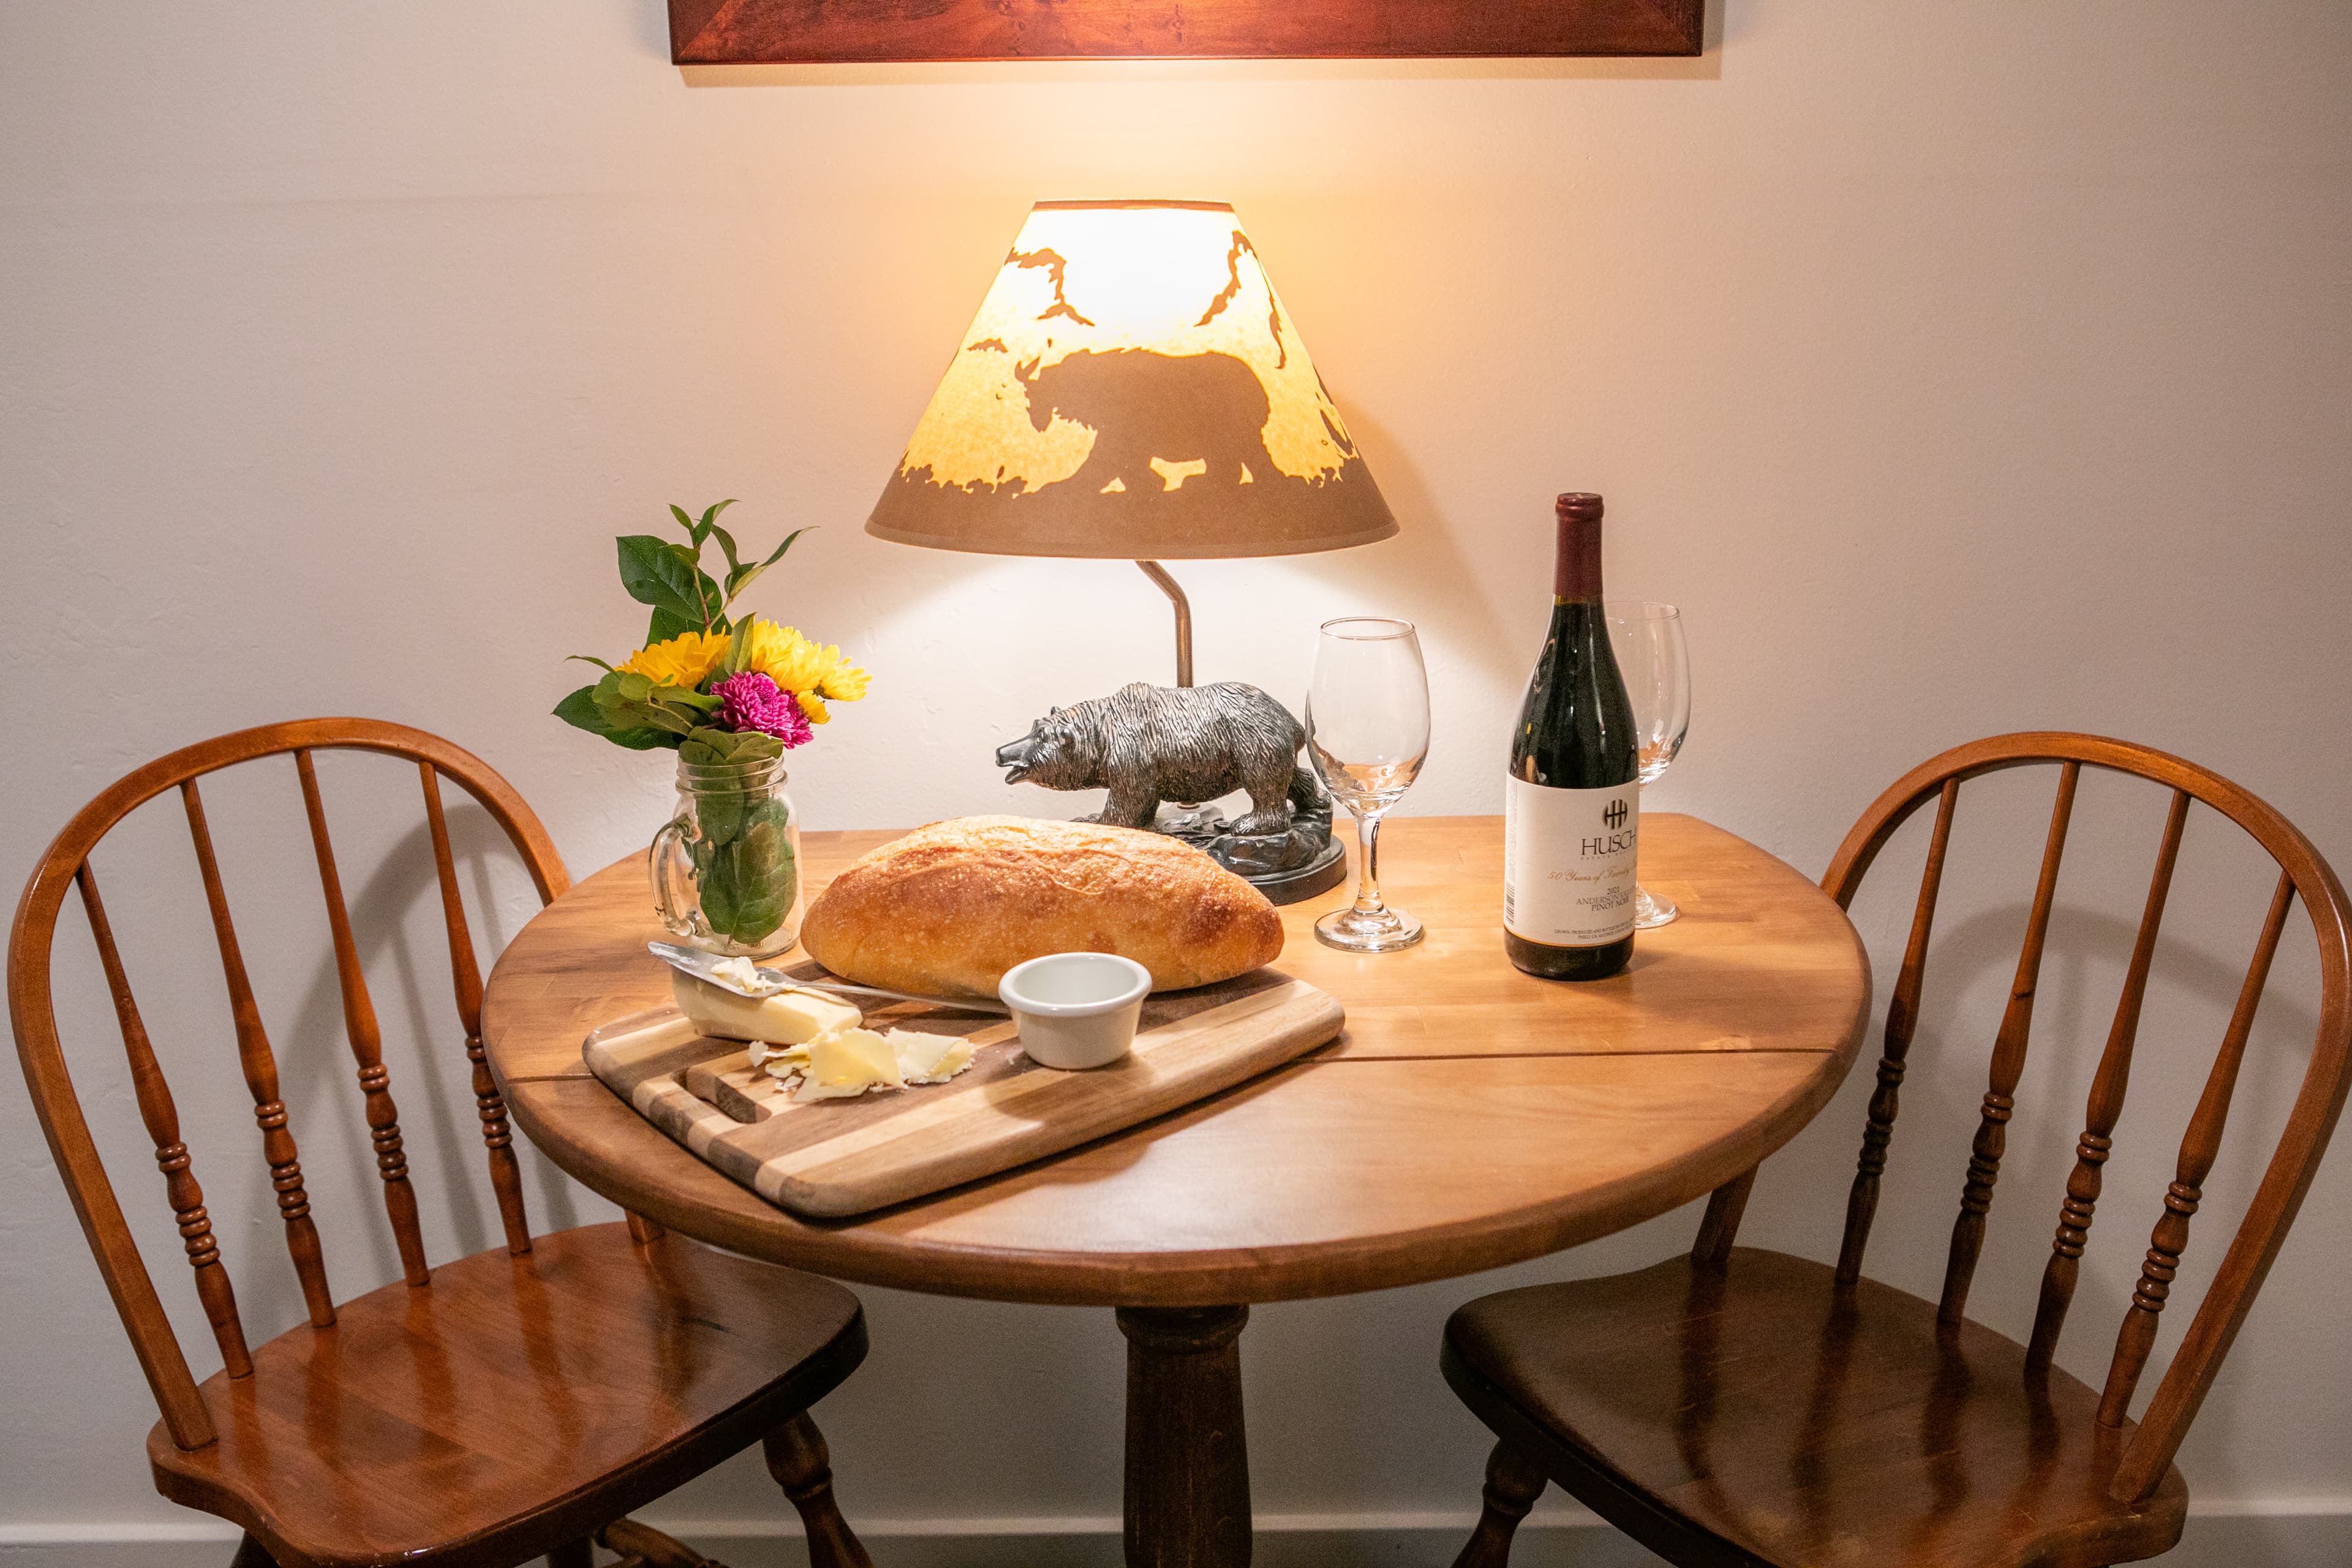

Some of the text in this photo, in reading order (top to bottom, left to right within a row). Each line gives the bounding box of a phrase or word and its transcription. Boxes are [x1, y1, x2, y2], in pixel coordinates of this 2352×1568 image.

[1581, 827, 1637, 856] HUSCH
[1548, 872, 1562, 880] 50
[1563, 869, 1591, 881] Years
[1592, 870, 1604, 884] of
[1576, 894, 1618, 905] ANDERSON
[1591, 901, 1614, 911] PINOT
